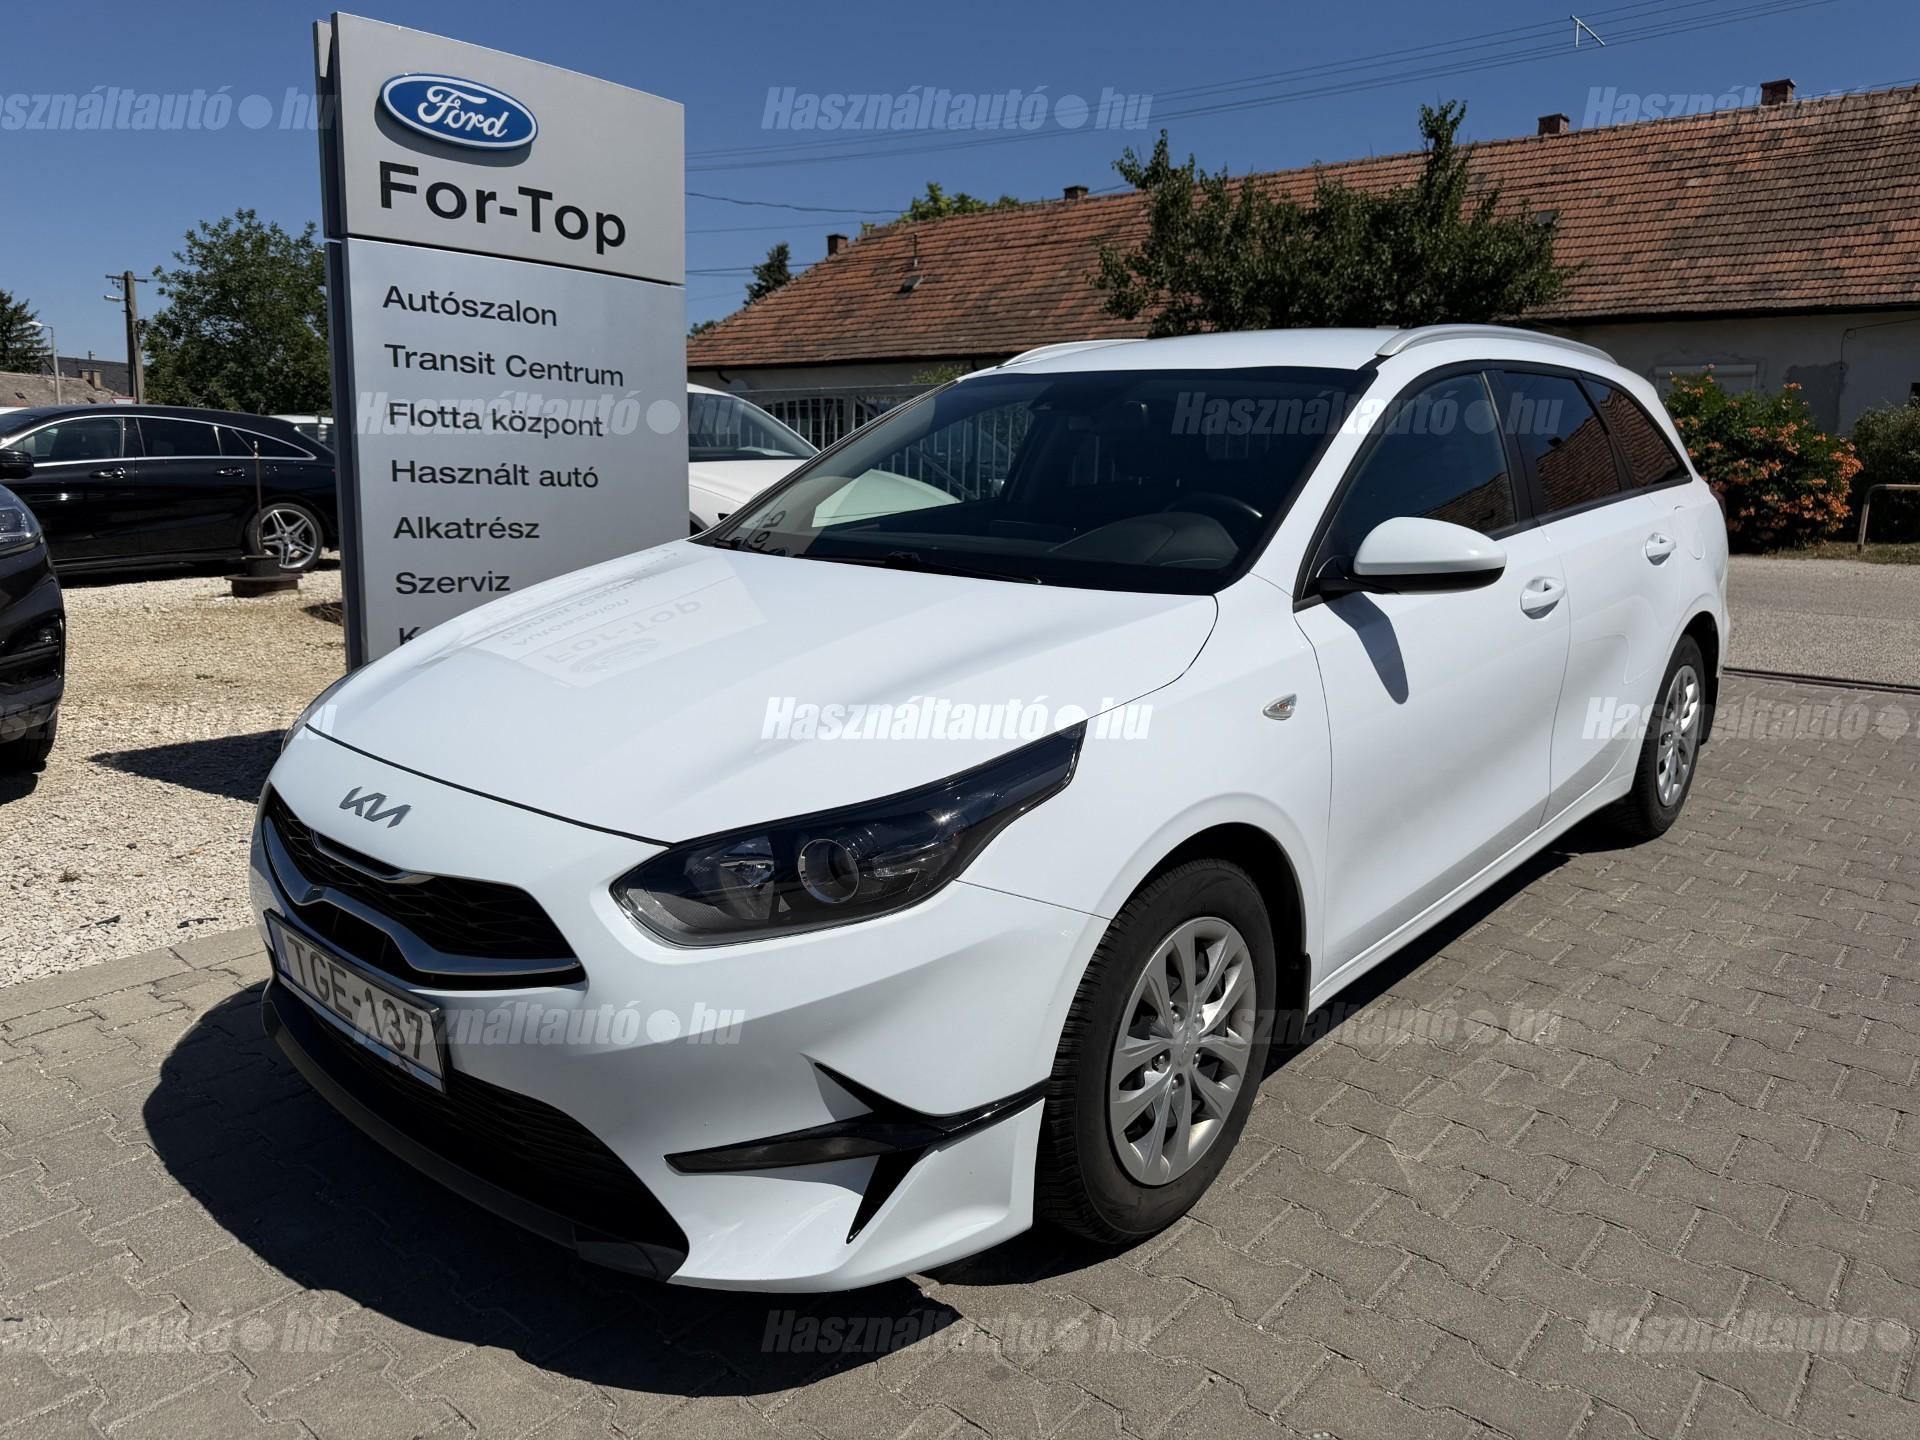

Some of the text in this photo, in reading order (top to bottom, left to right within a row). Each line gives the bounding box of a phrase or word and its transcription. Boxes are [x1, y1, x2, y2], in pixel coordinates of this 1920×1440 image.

[417, 85, 509, 138] Ford
[380, 161, 626, 254] For-Top
[383, 285, 557, 326] Autószalon
[384, 343, 624, 387] Transit Centrum
[389, 403, 604, 438] Flotta központ
[391, 460, 599, 488] Használt autó
[393, 516, 540, 539] Alkatrész
[395, 572, 511, 595] Szerviz
[287, 935, 424, 1060] TGE-137
